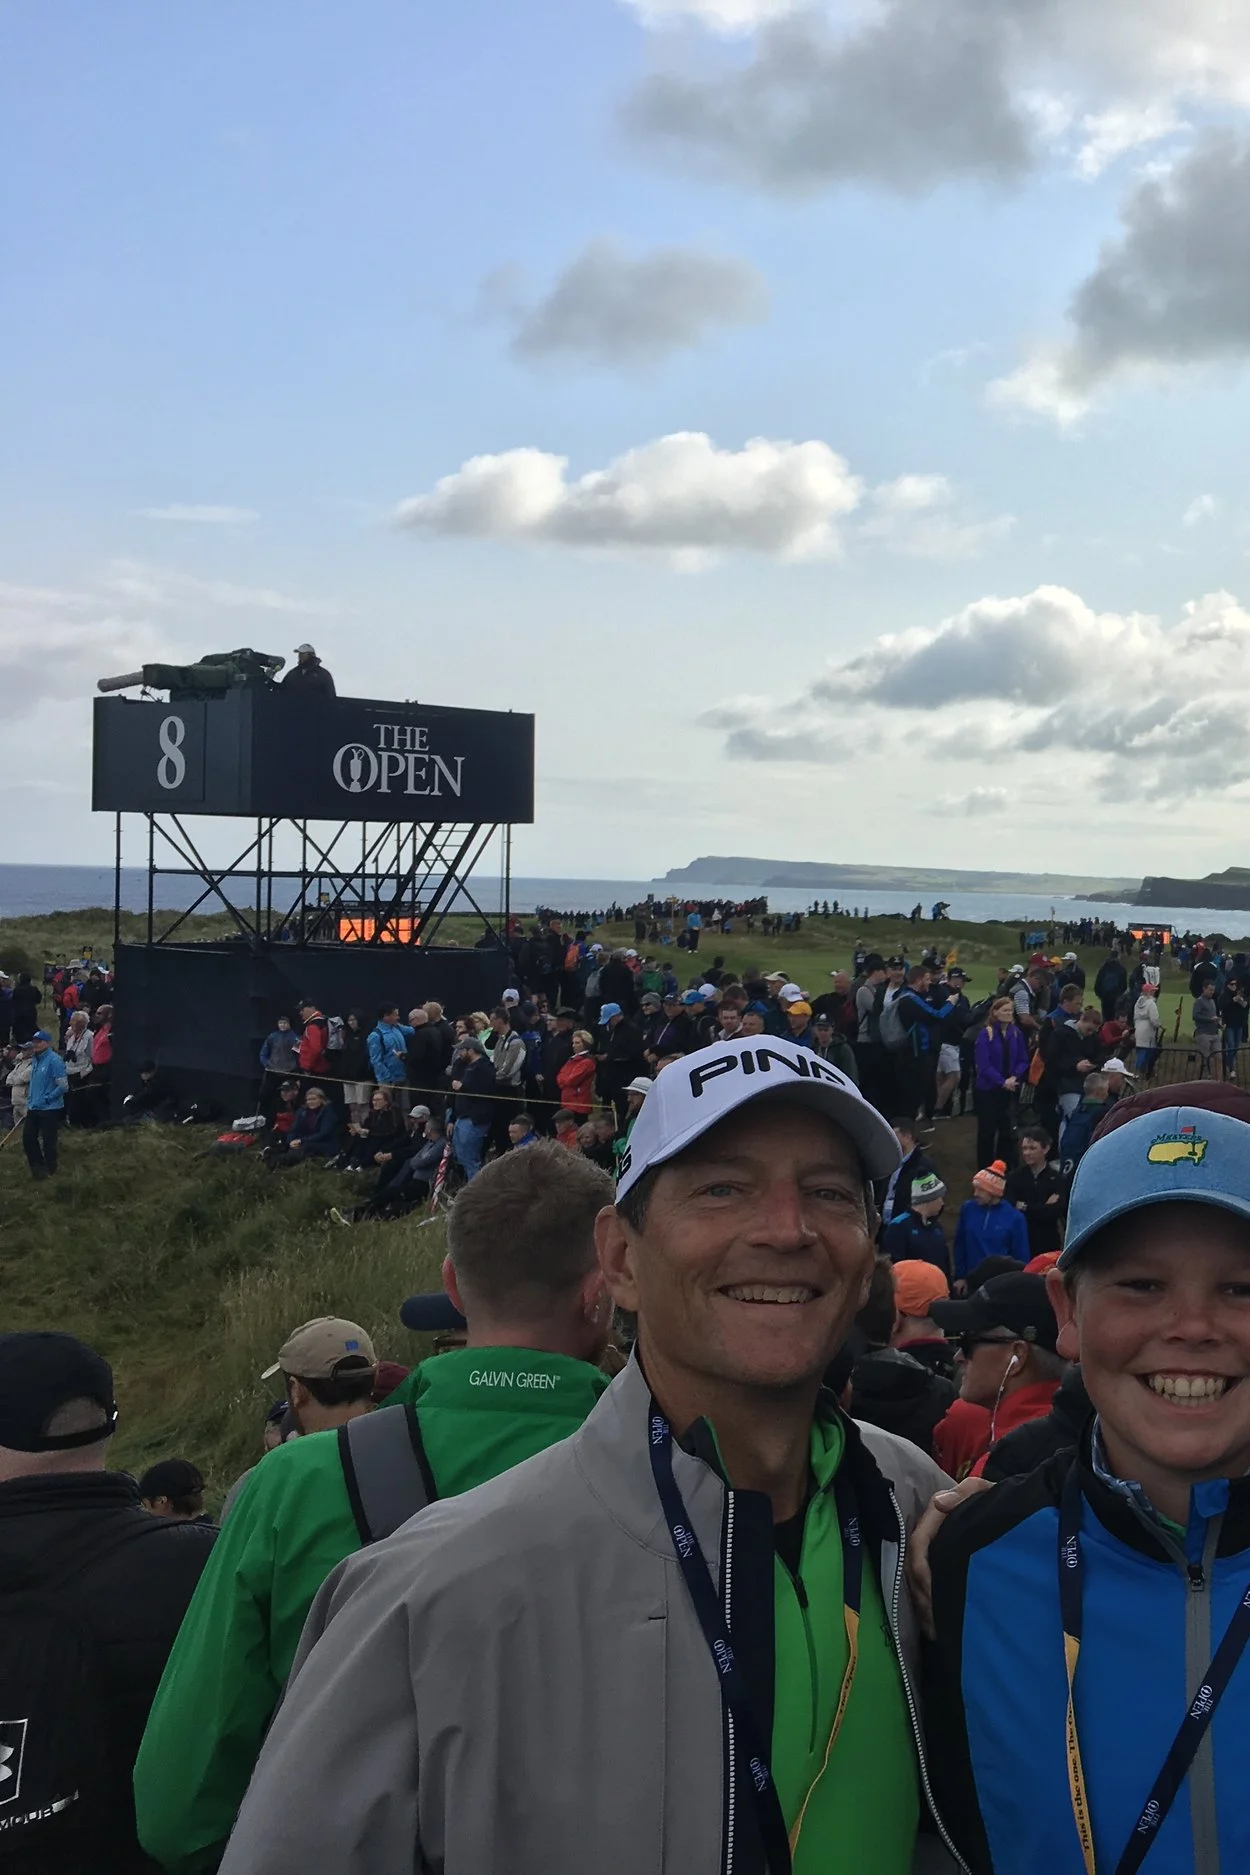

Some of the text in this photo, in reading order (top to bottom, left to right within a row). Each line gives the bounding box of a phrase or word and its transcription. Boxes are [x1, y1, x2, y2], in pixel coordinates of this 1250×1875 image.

[157, 716, 186, 789] 8
[373, 724, 429, 751] THE
[333, 743, 466, 797] OPEN
[469, 1371, 514, 1387] GALVIN
[673, 1525, 692, 1558] OPEN
[1066, 1535, 1077, 1568] OPEN
[714, 1640, 732, 1674] OPEN
[1190, 1685, 1213, 1720] OPEN
[750, 1757, 766, 1792] OPEN
[1137, 1800, 1160, 1834] OPEN
